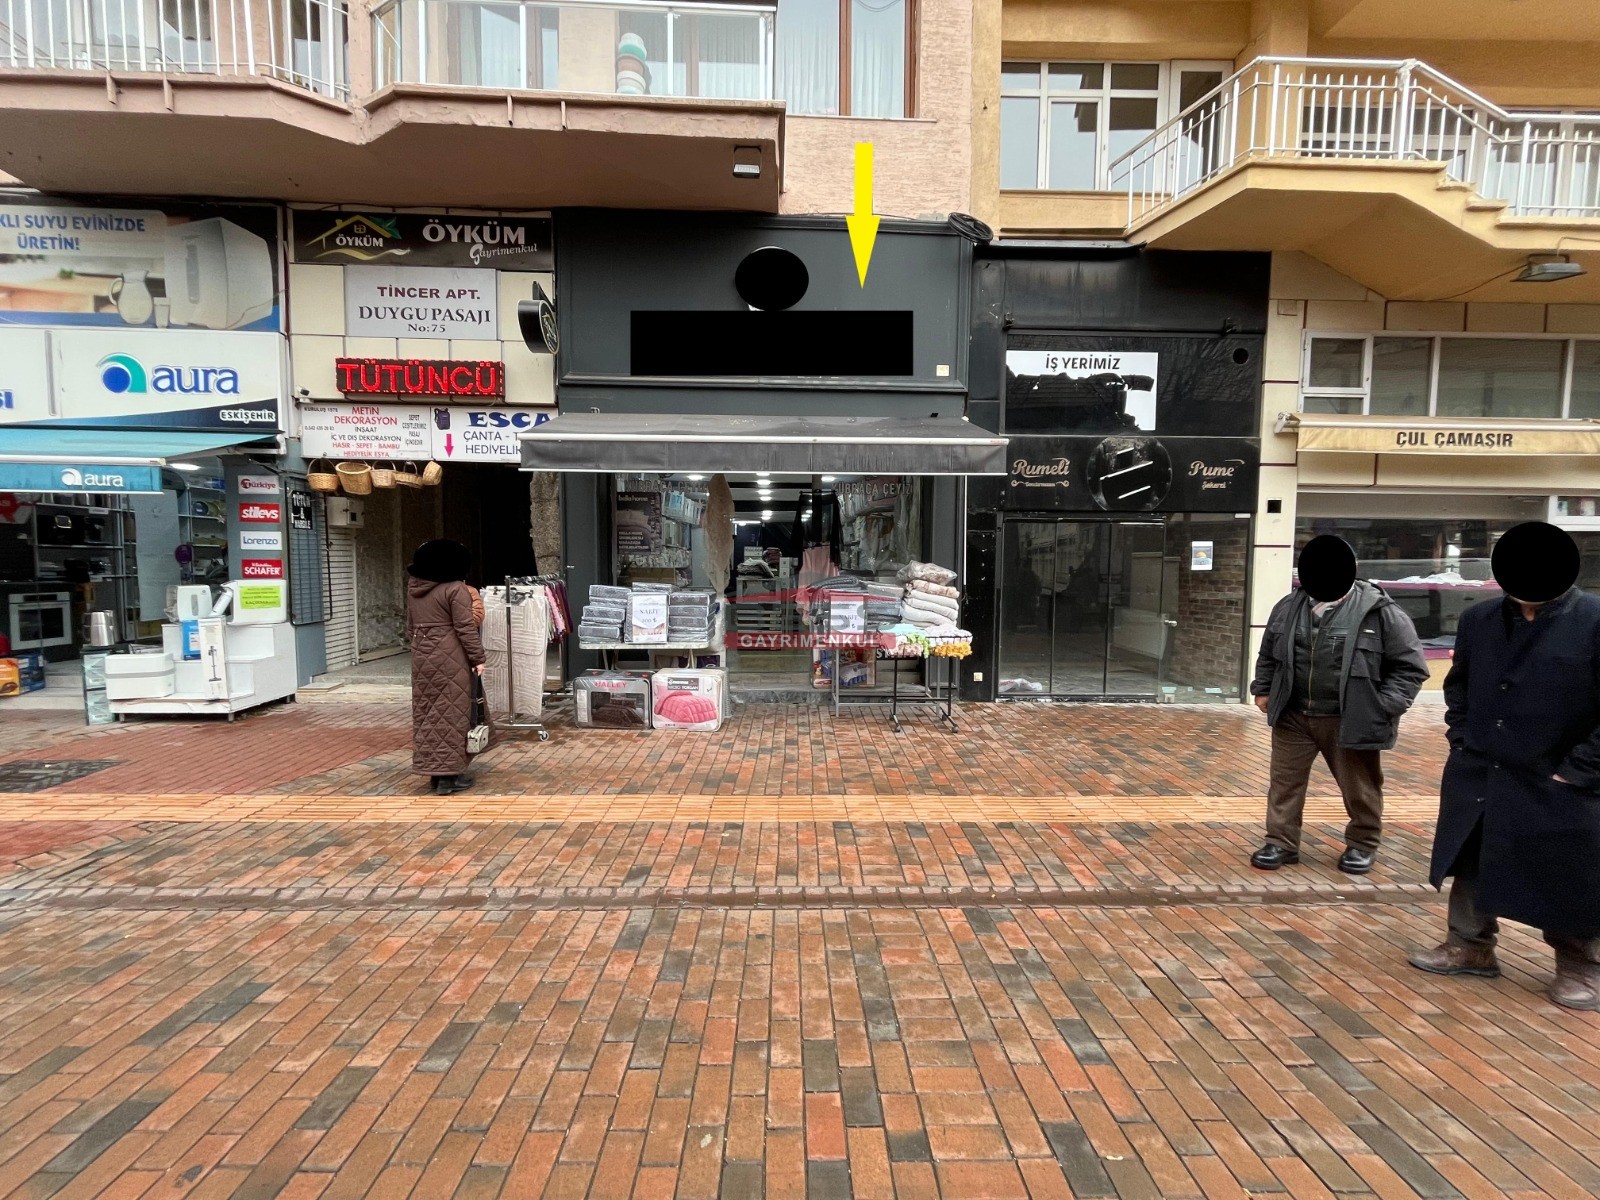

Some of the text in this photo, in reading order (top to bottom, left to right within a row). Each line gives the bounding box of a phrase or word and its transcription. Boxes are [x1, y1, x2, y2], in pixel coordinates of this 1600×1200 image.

[25, 215, 67, 230] SUYU
[72, 214, 146, 233] EVİNİZDE
[422, 218, 526, 245] ÖYKÜM
[17, 233, 81, 251] ÜRETİN!
[335, 234, 384, 248] ÖYKÜM
[469, 243, 538, 266] Gayrimenkul
[377, 285, 481, 300] TİNCER APT.
[358, 305, 491, 325] DUYGU PASAJI
[1045, 354, 1121, 372] İŞ YERİMİZ
[152, 365, 240, 395] aura
[337, 360, 497, 394] TÜTÜNCÜ
[219, 408, 276, 424] ESKİŞEHİR
[351, 407, 380, 415] METİN
[334, 416, 398, 425] DEKORASYON
[354, 425, 378, 433] İNŞAAT
[463, 430, 502, 442] ÇANTA
[1396, 432, 1513, 448] ÇUL ÇAMAŞIR
[1011, 457, 1070, 478] Rumeli
[84, 471, 124, 487] aura
[241, 507, 279, 519] stilevs
[242, 536, 279, 545] Lorenzo
